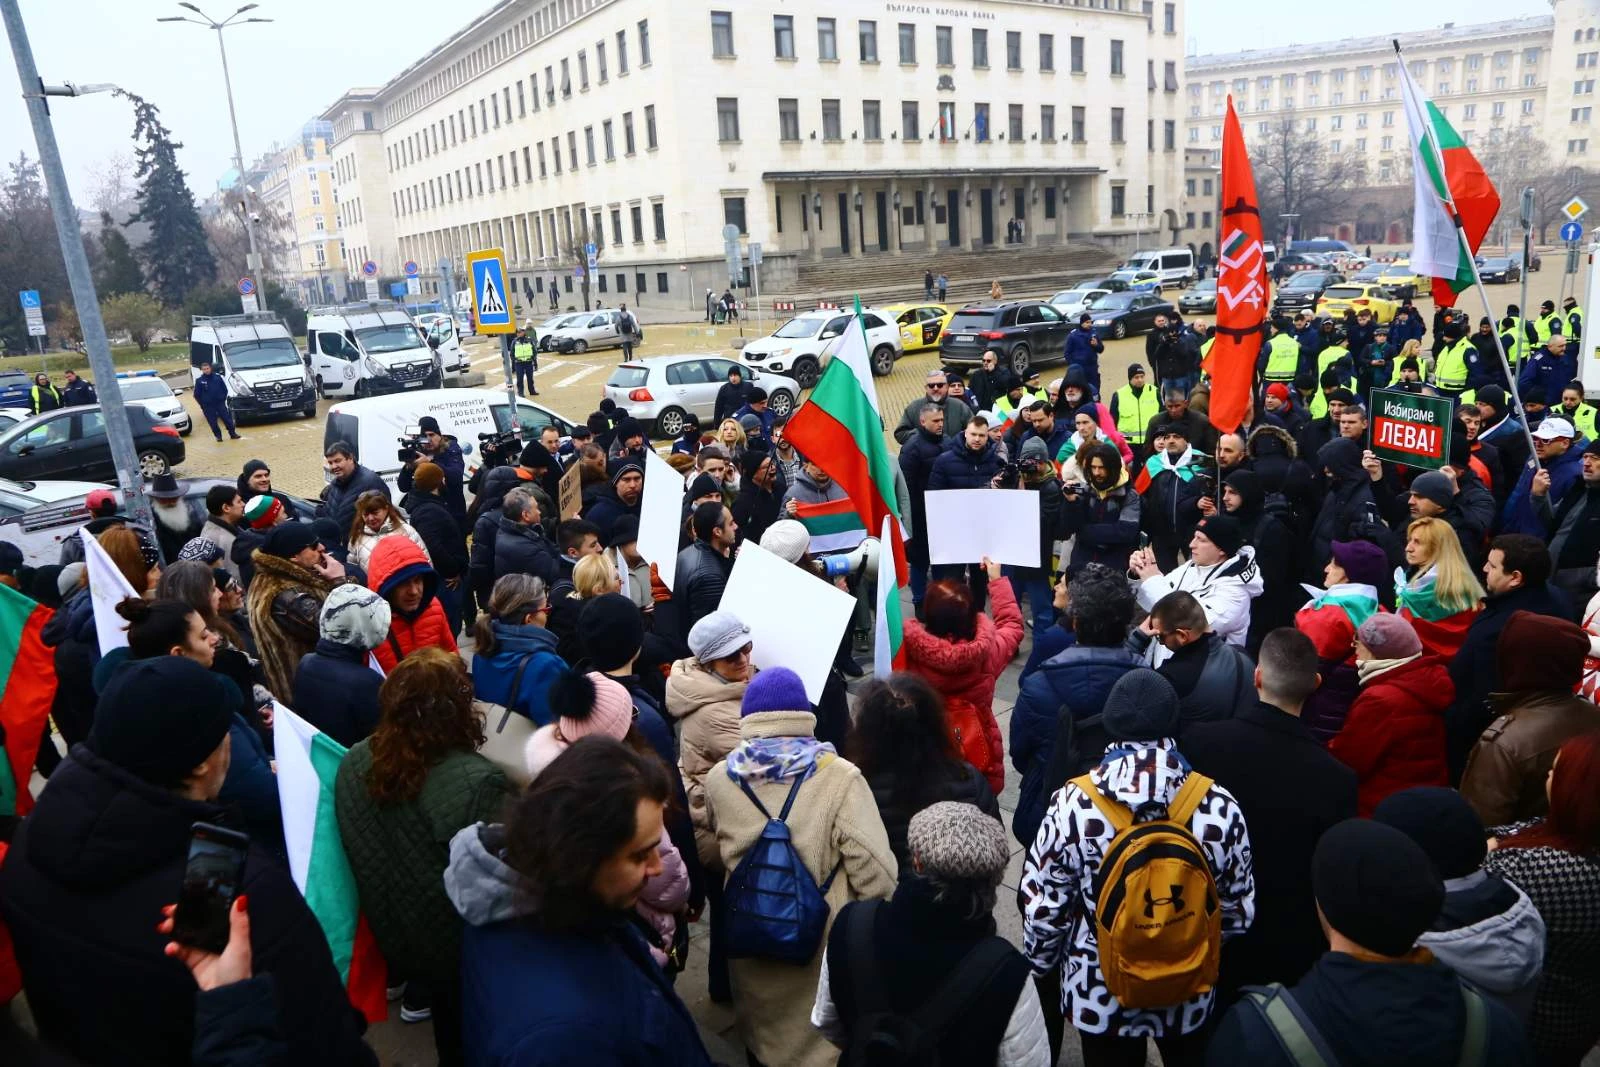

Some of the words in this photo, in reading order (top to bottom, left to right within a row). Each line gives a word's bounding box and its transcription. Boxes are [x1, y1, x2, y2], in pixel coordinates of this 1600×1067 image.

[886, 3, 930, 14] БЪЛГАРСКА
[935, 8, 968, 18] НАРОДНА
[972, 11, 996, 20] БАНКА
[428, 398, 485, 412] ИНСТРУМЕНТИ
[1384, 400, 1434, 422] Избираме
[449, 407, 487, 419] ДЮБЕЛИ
[454, 416, 489, 427] АНКЕРИ
[1379, 421, 1436, 453] ЛЕВА!
